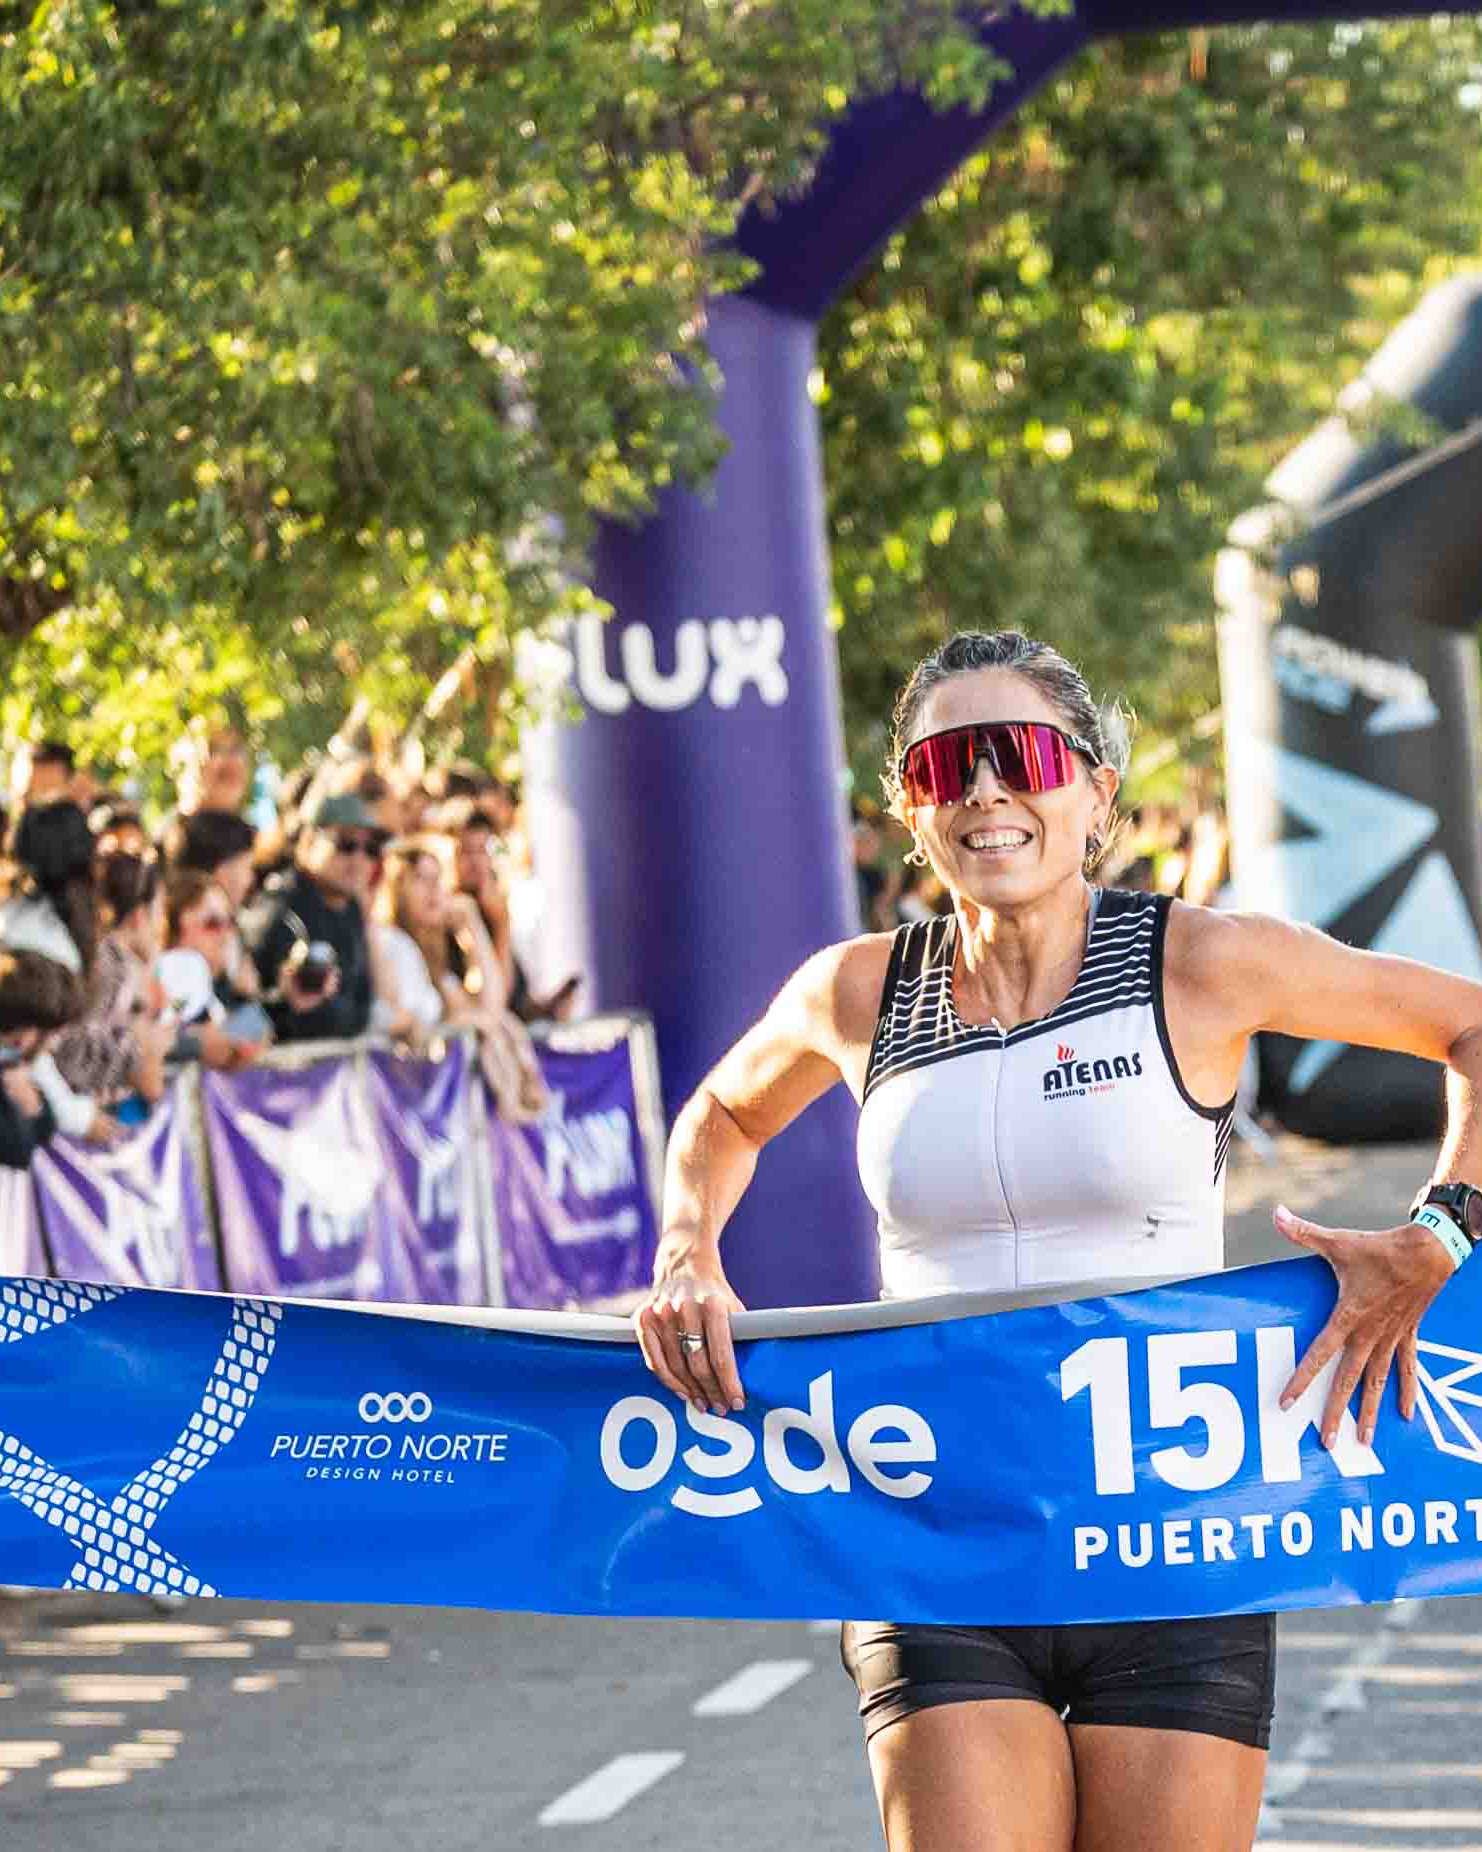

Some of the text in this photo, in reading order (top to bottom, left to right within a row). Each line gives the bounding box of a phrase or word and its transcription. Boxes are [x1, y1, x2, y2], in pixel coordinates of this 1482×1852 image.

[1043, 1051, 1143, 1092] ATENAS
[1044, 1088, 1086, 1102] running
[1059, 1325, 1387, 1497] 15K
[270, 1433, 508, 1462] PUERTO NORTE
[600, 1369, 939, 1500] osde
[305, 1466, 456, 1484] DESIGN HOTEL
[1073, 1510, 1315, 1570] PUERTO
